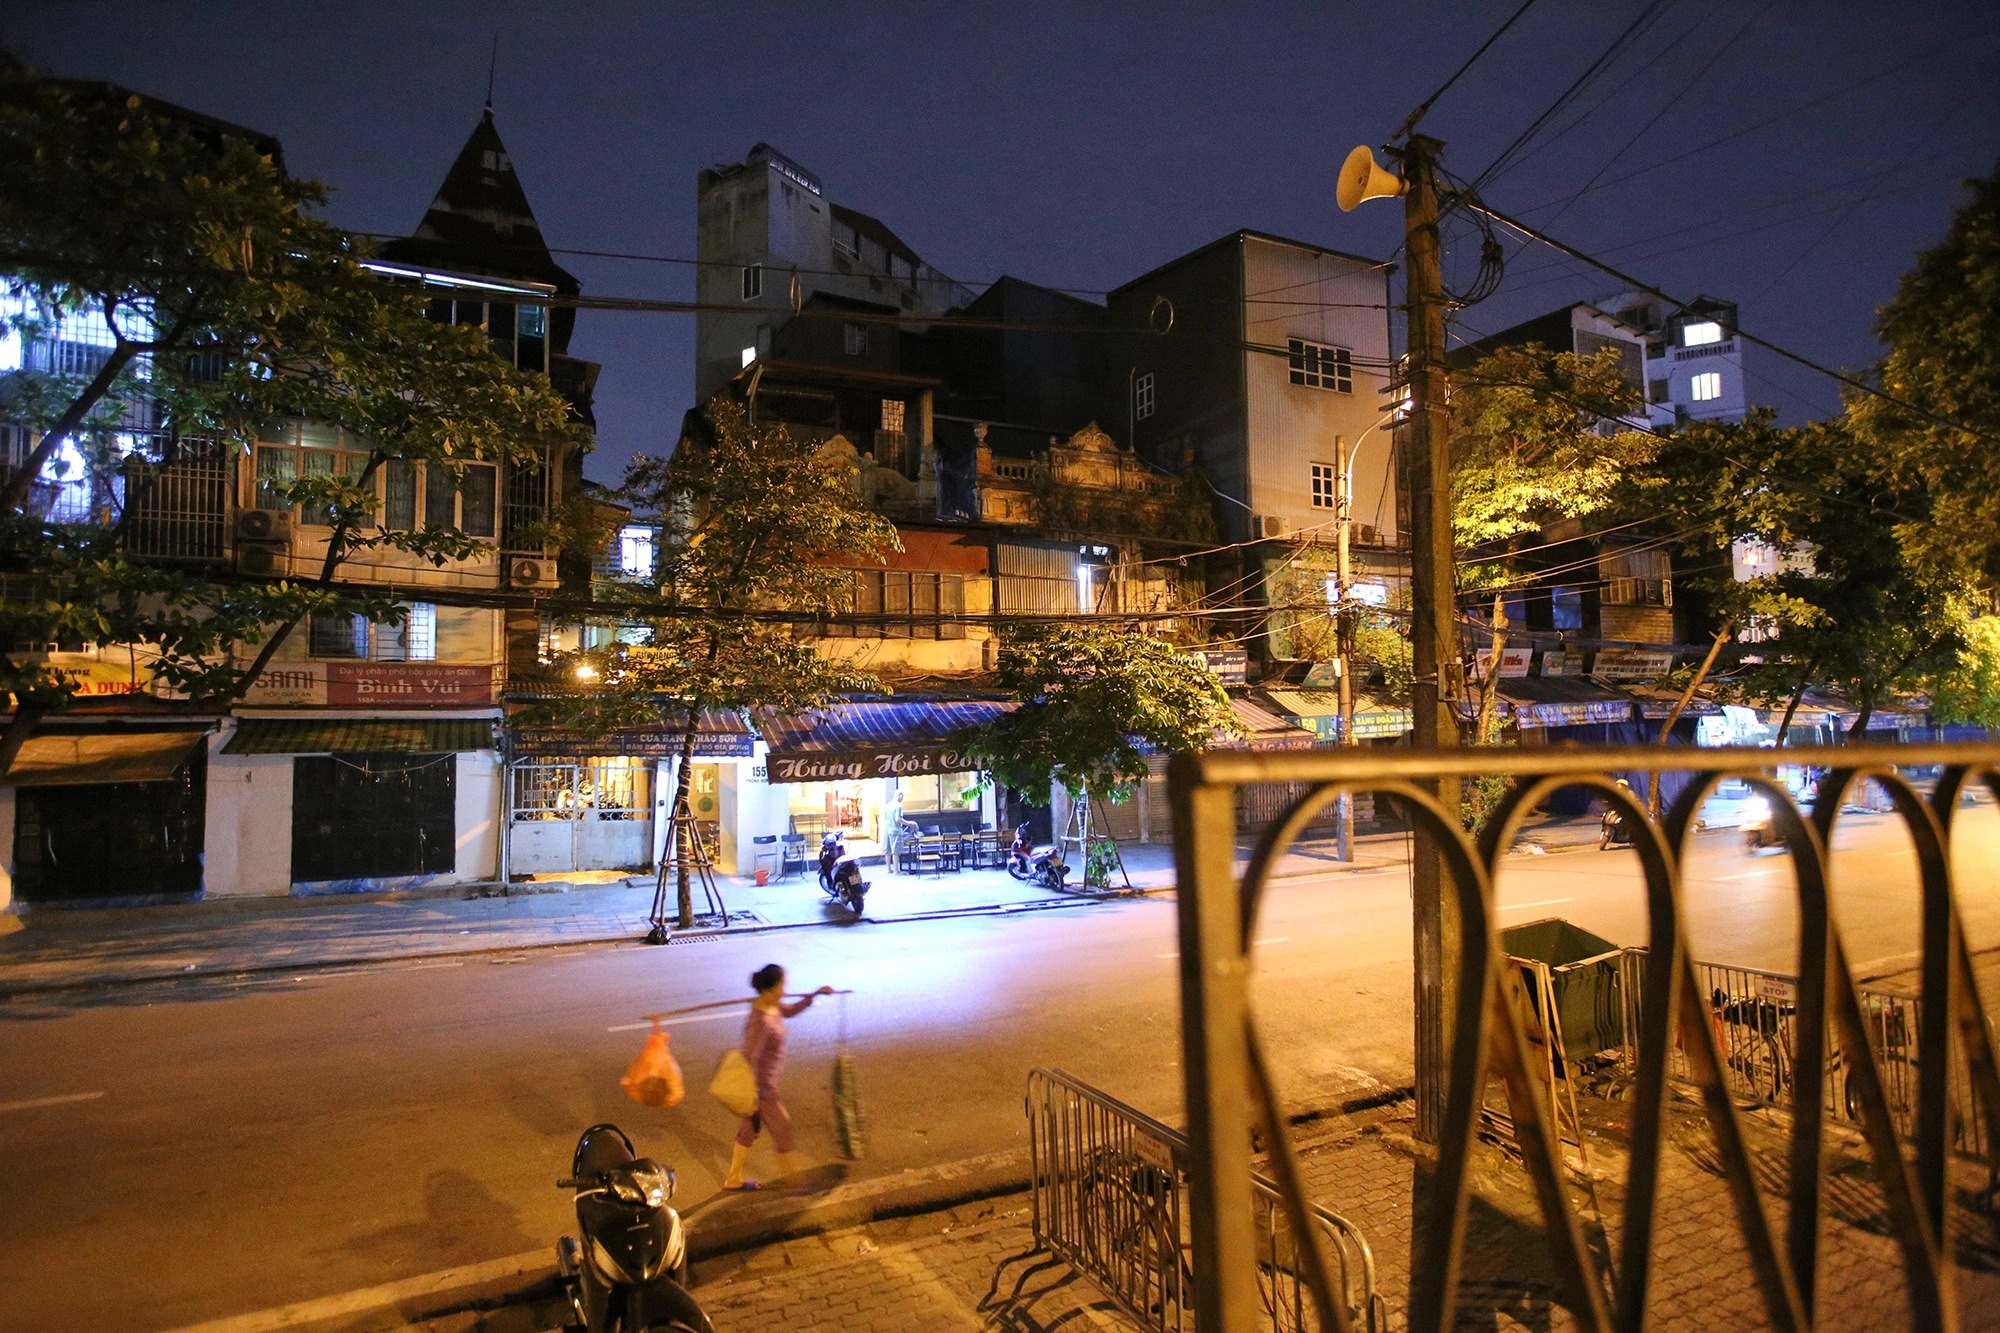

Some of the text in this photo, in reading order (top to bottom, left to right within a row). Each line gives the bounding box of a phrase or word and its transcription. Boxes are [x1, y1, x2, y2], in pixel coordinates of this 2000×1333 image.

[255, 670, 314, 689] SAMI
[356, 678, 461, 694] Bình Vui
[640, 733, 660, 742] CỬA
[718, 732, 738, 743] SƠN
[751, 766, 767, 777] 155
[775, 758, 866, 779] Hùng
[873, 753, 932, 773] Hói
[1762, 985, 1788, 997] STOP
